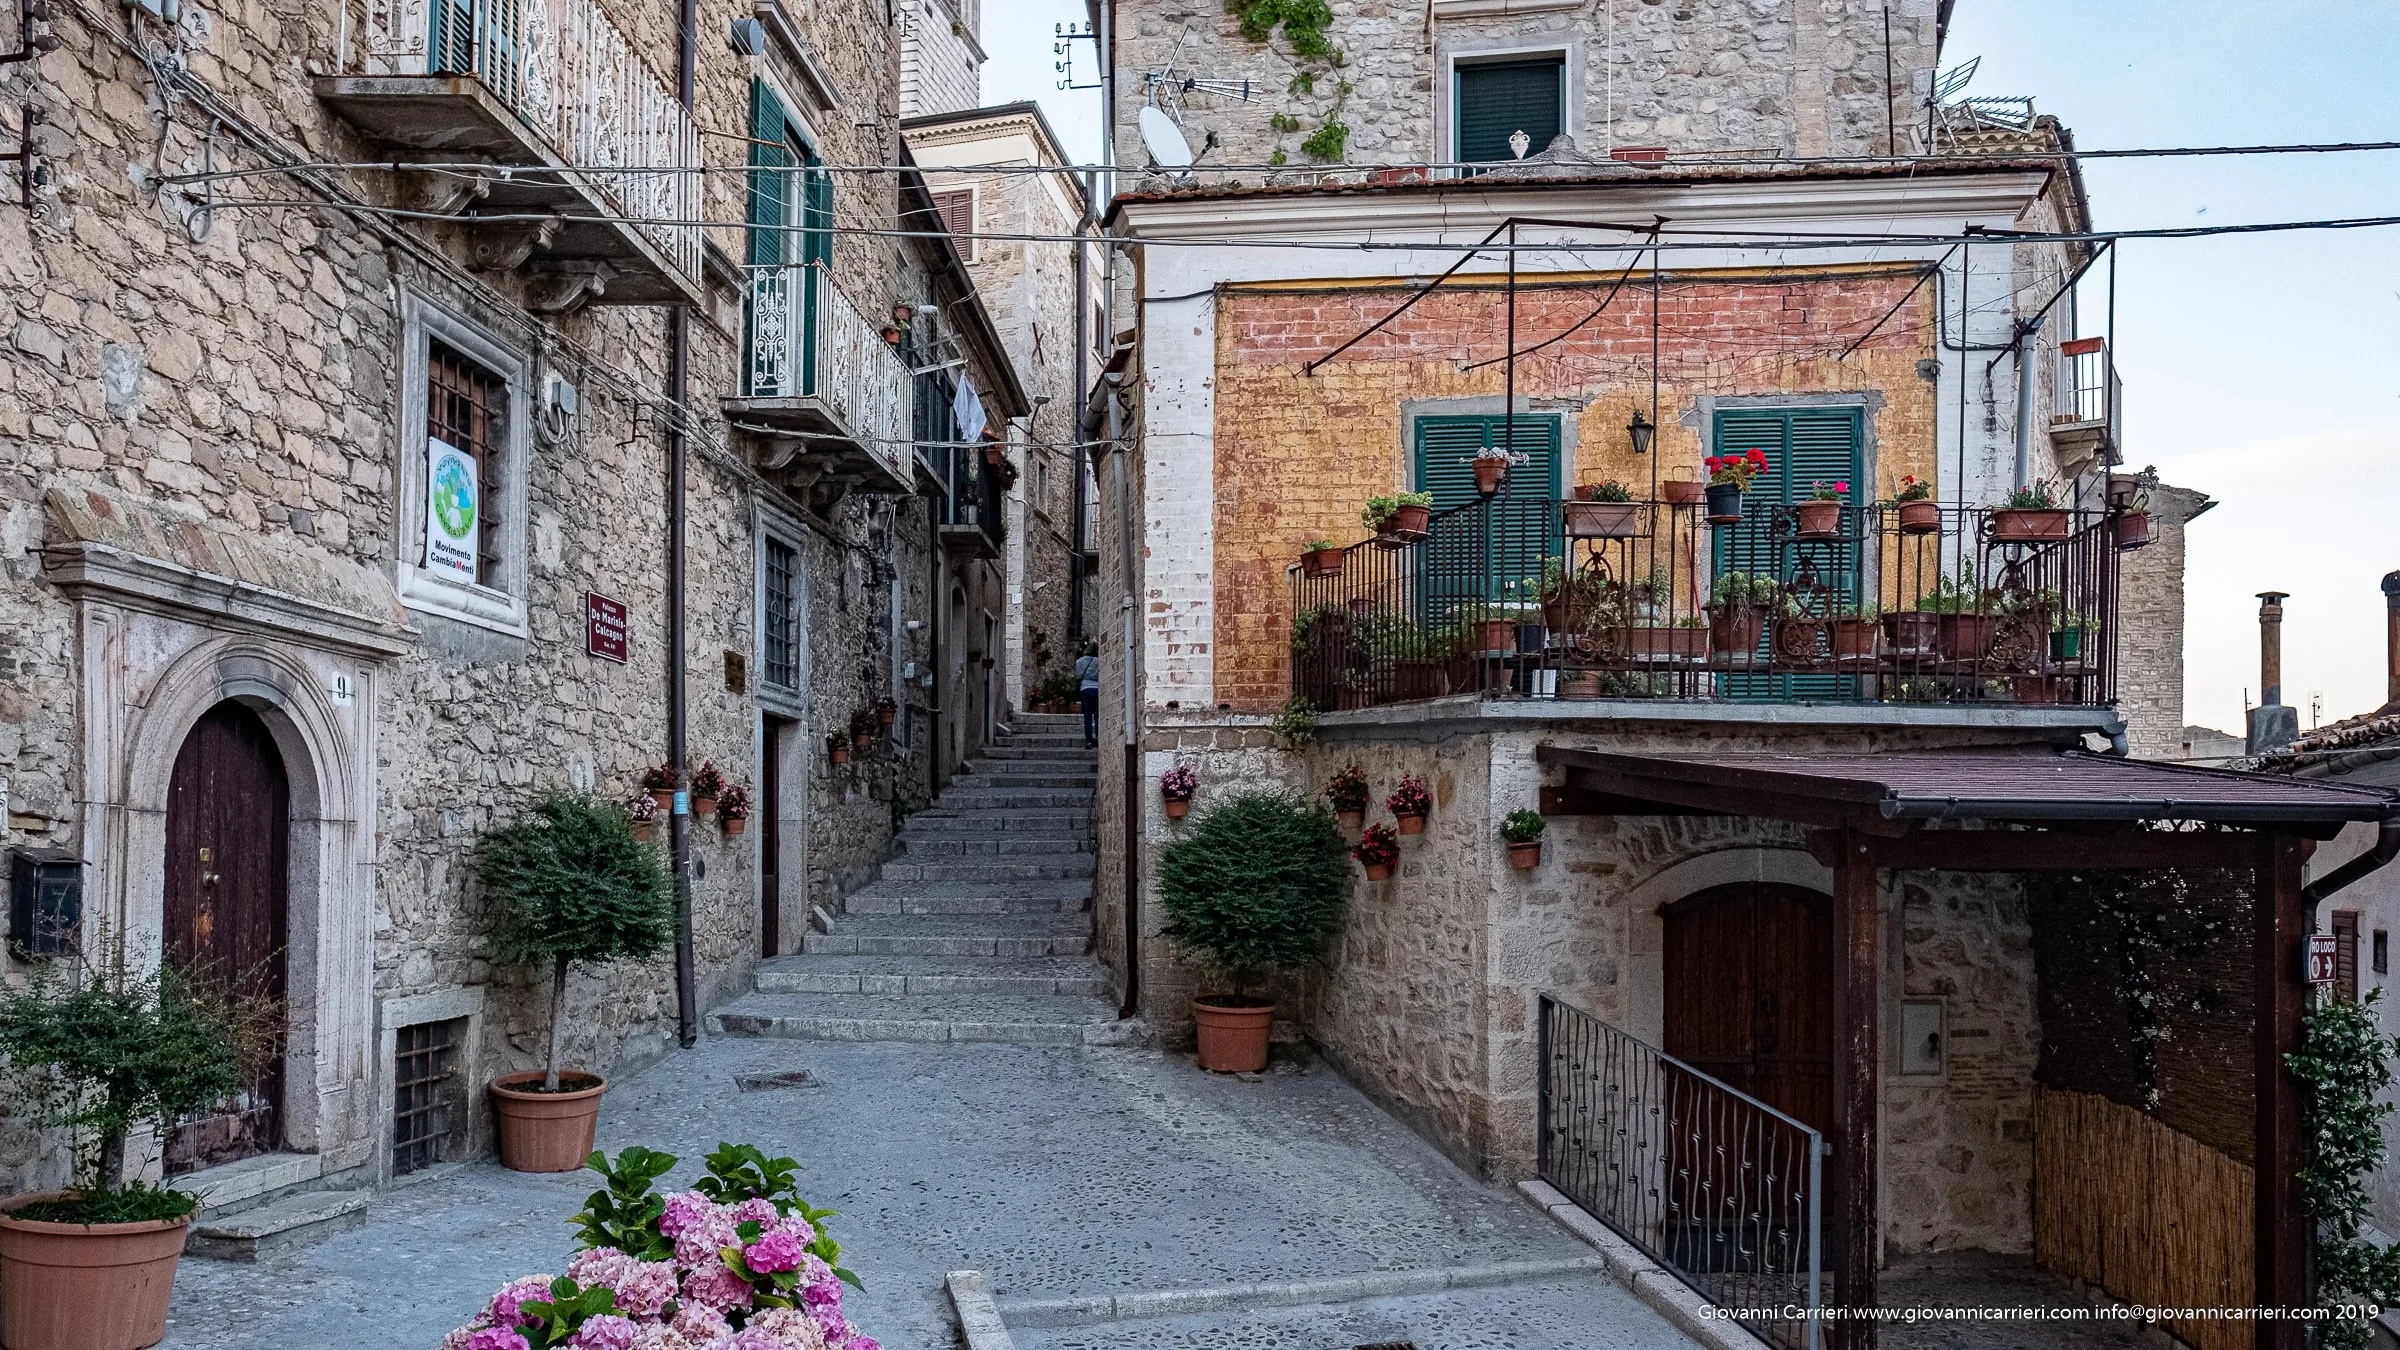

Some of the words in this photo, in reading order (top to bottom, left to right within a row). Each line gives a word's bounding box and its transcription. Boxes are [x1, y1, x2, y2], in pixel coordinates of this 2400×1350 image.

[435, 540, 471, 561] Movimento
[430, 552, 474, 575] CambiaMenti
[591, 608, 600, 620] De
[595, 623, 623, 641] Calcagno
[337, 676, 346, 699] 9
[2320, 941, 2335, 953] LOCO
